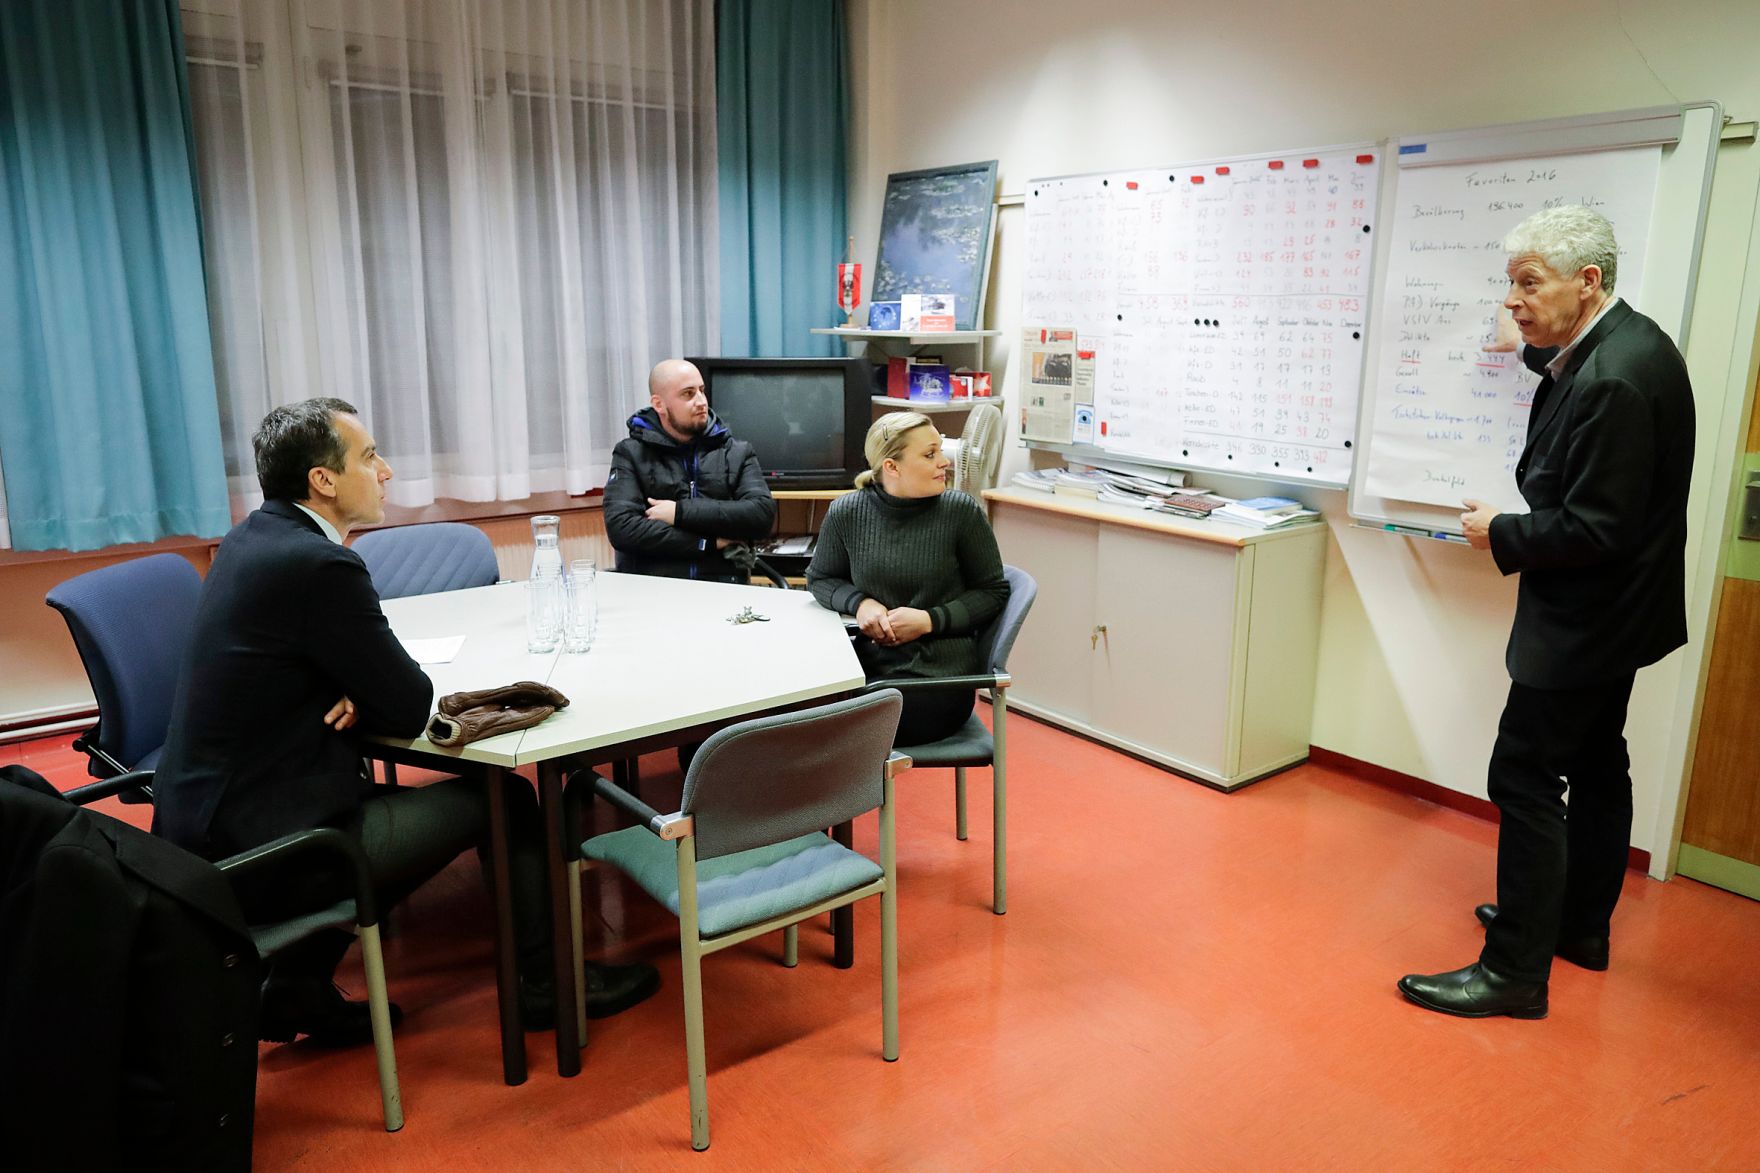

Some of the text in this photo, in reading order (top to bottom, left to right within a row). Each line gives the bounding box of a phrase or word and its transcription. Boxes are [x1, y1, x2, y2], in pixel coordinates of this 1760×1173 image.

[1465, 169, 1558, 188] Favoriten 2016
[1279, 330, 1294, 342] 62
[1302, 331, 1314, 343] 64
[1277, 347, 1292, 358] 50
[1276, 363, 1290, 374] 17
[1301, 364, 1313, 375] 17
[1274, 423, 1288, 435] 25
[1315, 426, 1329, 440] 20
[1271, 445, 1289, 459] 355
